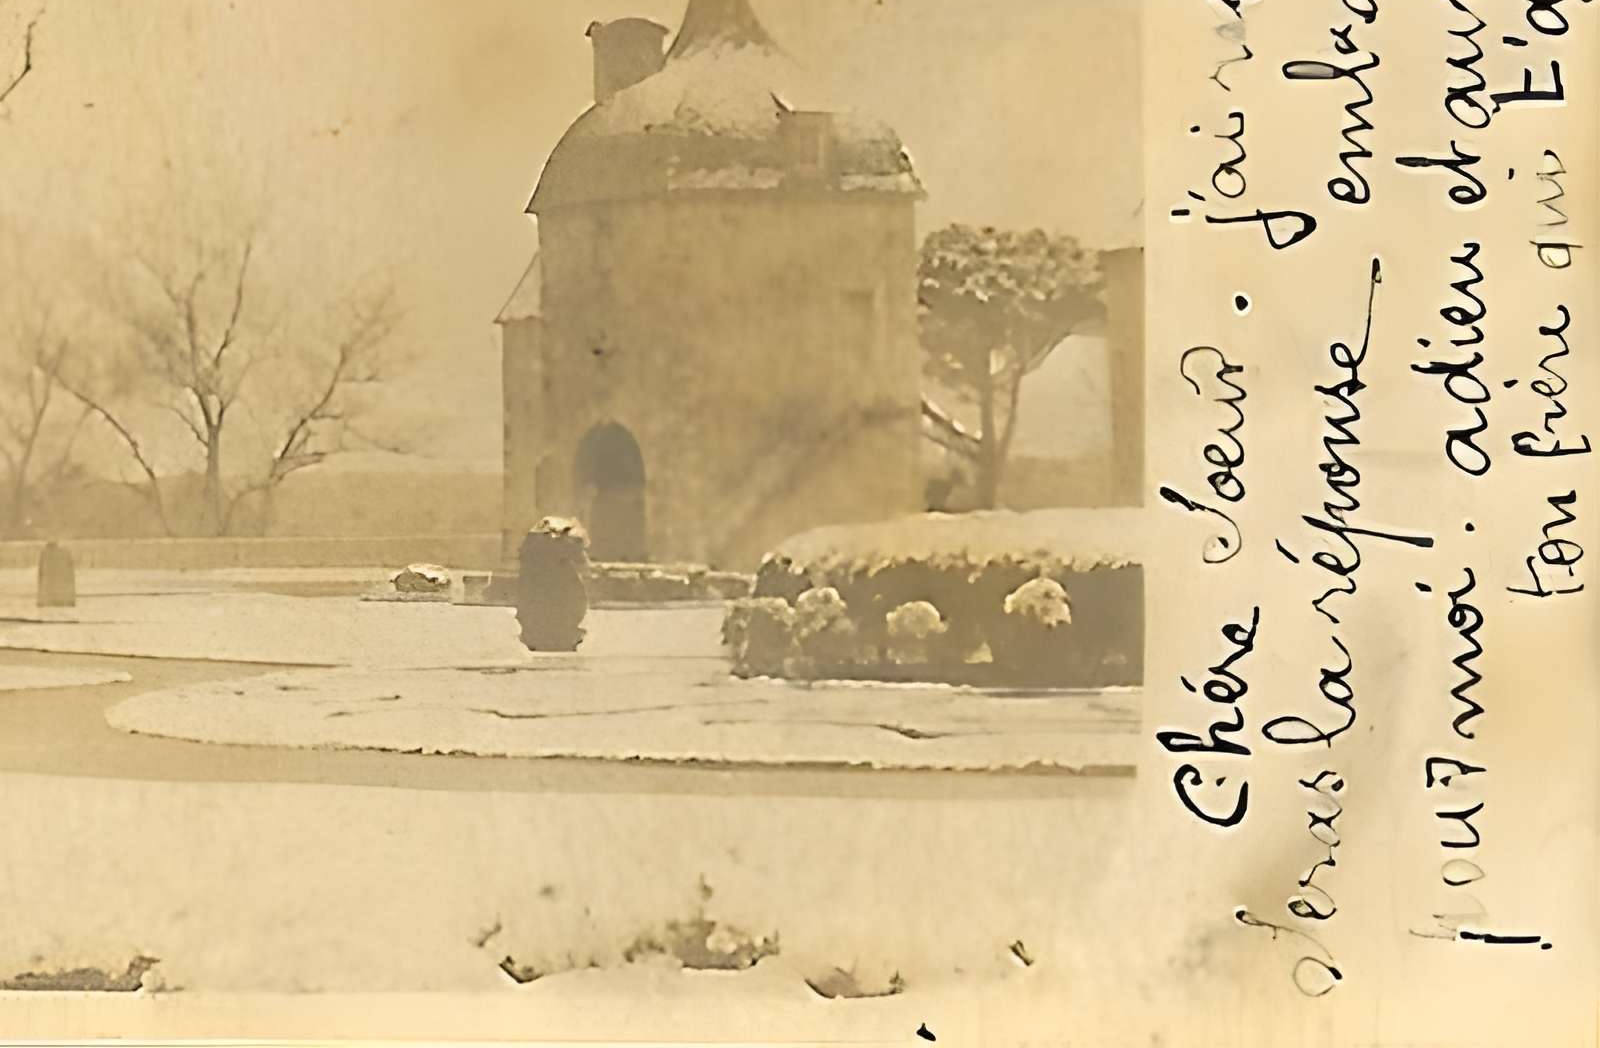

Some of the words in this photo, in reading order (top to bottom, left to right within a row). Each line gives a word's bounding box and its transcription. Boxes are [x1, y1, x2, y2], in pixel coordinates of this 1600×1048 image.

[1170, 111, 1317, 249] j'ai
[1395, 139, 1488, 204] et
[1508, 147, 1584, 268] qui
[1410, 241, 1491, 476] adieu
[1275, 256, 1434, 623] réponse
[1504, 488, 1586, 599] ton
[1262, 635, 1356, 745] la
